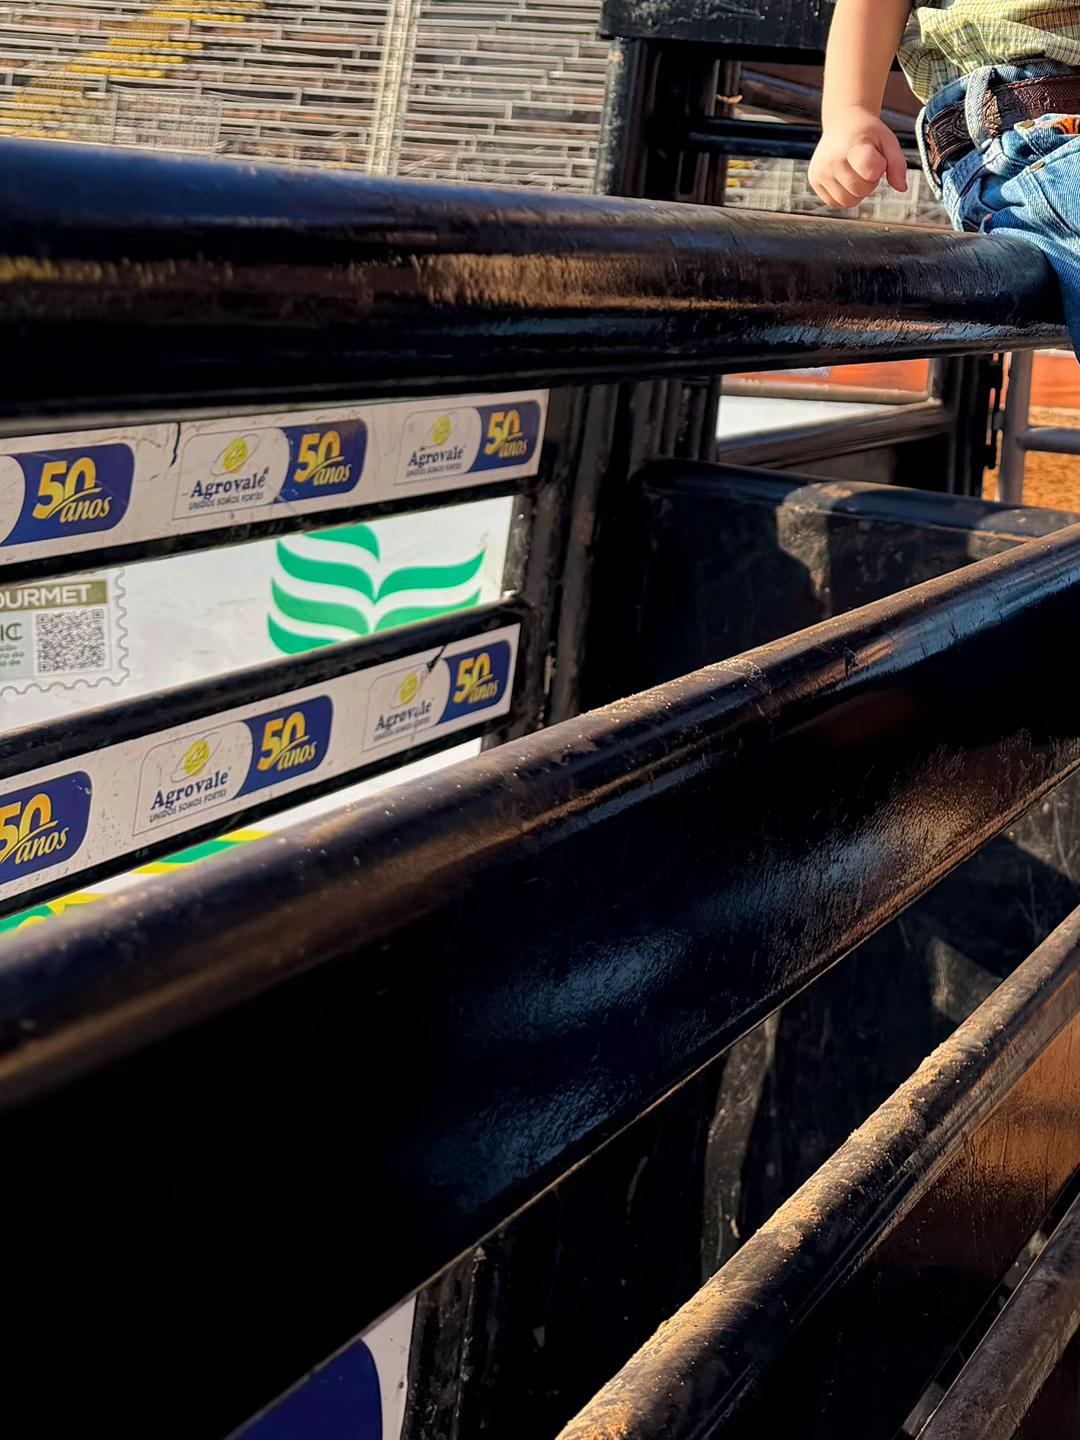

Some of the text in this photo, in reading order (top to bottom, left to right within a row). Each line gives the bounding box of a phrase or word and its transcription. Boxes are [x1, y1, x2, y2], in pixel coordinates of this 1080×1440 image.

[484, 409, 520, 455] 50
[293, 430, 342, 483] 50
[313, 464, 351, 486] anos
[408, 446, 464, 468] Agrovale
[32, 457, 97, 519] 50
[190, 469, 266, 502] Agrovale
[60, 496, 112, 523] anos
[453, 653, 492, 703] 50
[257, 711, 307, 771] 50
[277, 741, 317, 771] anos
[150, 769, 230, 809] Agrovale
[0, 793, 52, 864] 50
[15, 827, 69, 864] anos
